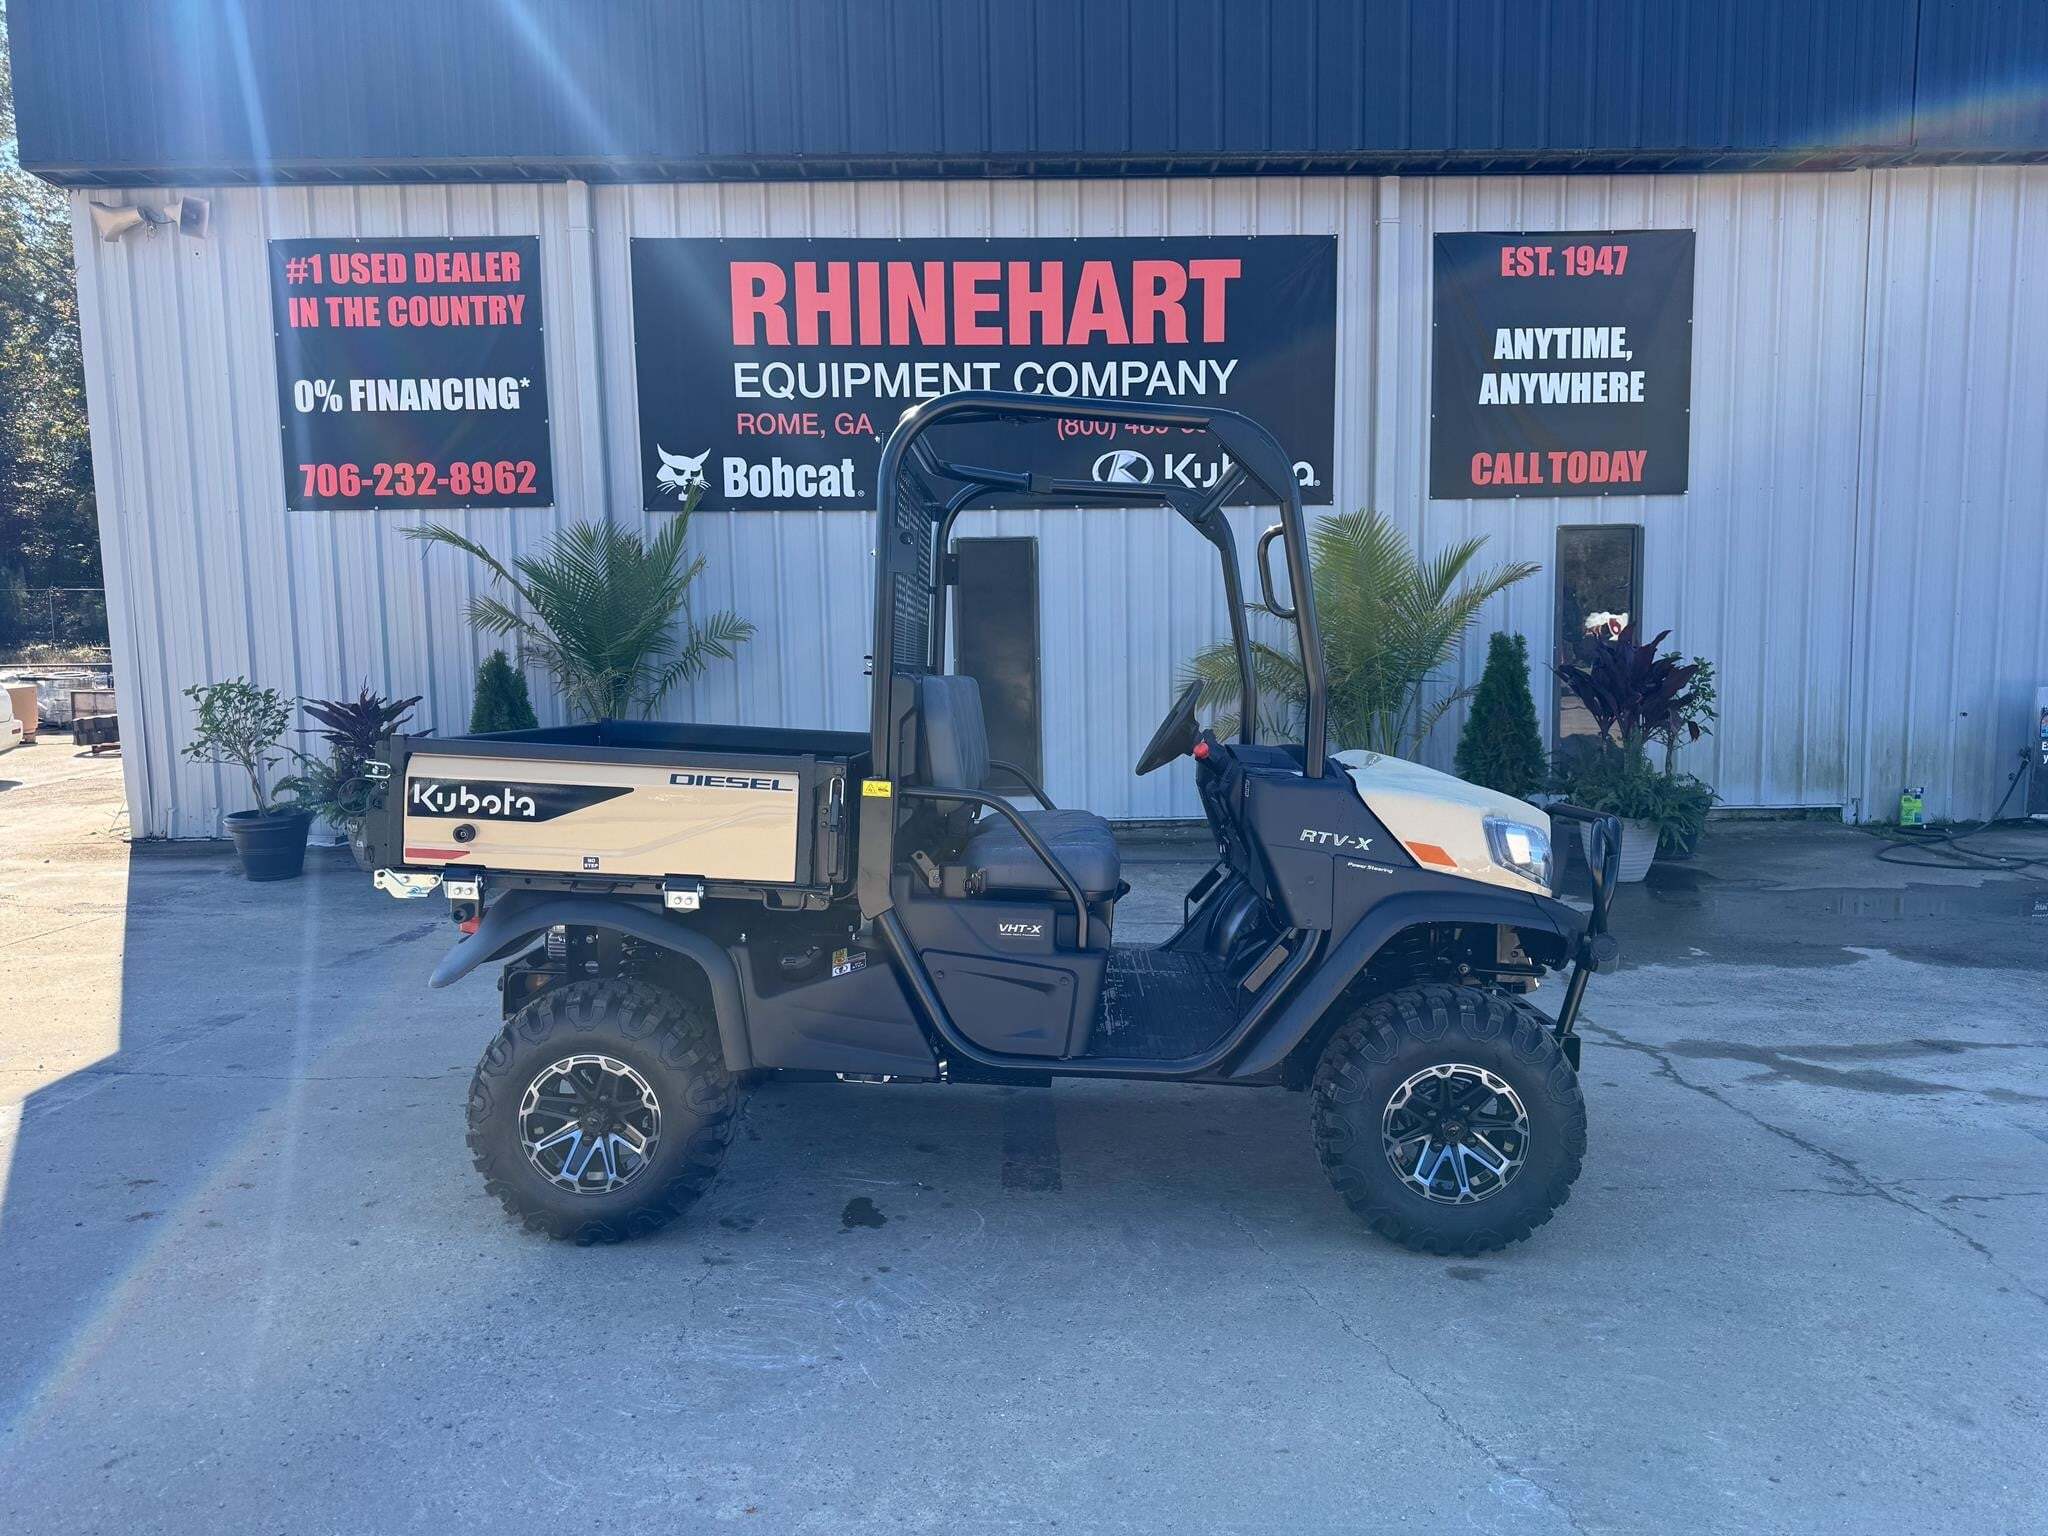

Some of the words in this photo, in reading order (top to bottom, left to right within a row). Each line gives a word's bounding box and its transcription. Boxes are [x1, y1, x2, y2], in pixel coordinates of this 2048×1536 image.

[286, 254, 323, 285] #1
[329, 252, 407, 284] USED
[415, 251, 521, 283] DEALER
[1500, 246, 1555, 277] EST.
[1561, 245, 1629, 276] 1947
[288, 296, 319, 328] IN
[325, 296, 381, 327] THE
[387, 294, 526, 327] COUNTRY
[730, 259, 1241, 346] RHINEHART
[1493, 326, 1633, 362] ANYTIME,
[294, 379, 343, 413] 0%
[734, 361, 1001, 400] EQUIPMENT
[1013, 359, 1239, 397] COMPANY
[1478, 371, 1646, 405] ANYWHERE
[737, 412, 827, 439] ROME,
[834, 412, 875, 435] GA
[299, 460, 537, 498] 706-232-8962
[722, 456, 857, 499] Bobcat
[1471, 451, 1544, 486] CALL
[1548, 450, 1648, 484] TODAY
[669, 773, 793, 792] DIESEL
[413, 783, 536, 817] Kubota
[1299, 829, 1374, 851] RTV-X
[999, 923, 1043, 934] VHT-X
